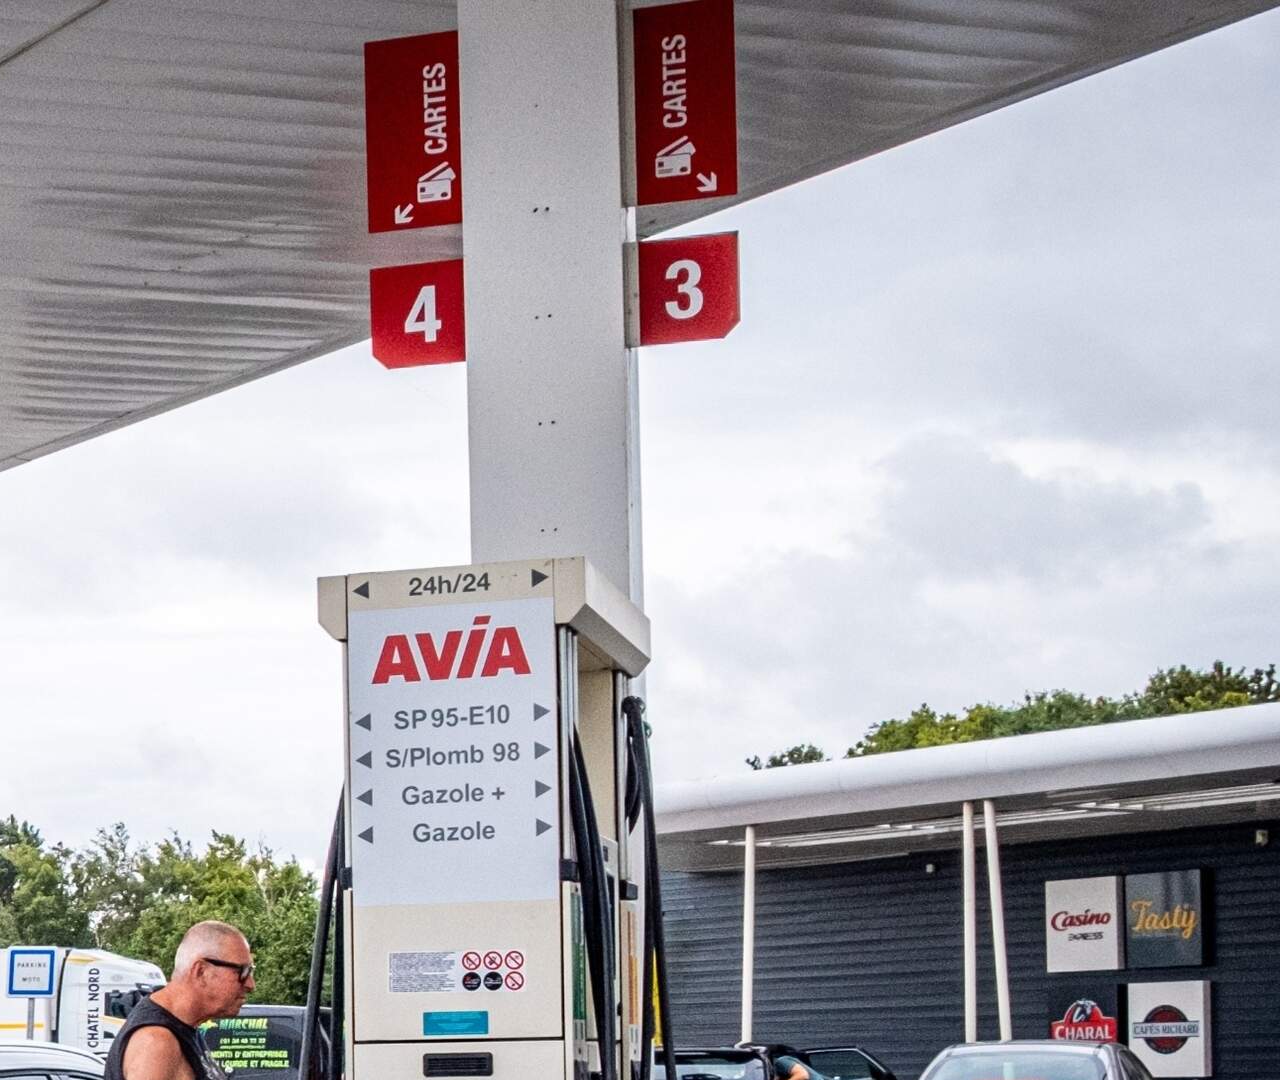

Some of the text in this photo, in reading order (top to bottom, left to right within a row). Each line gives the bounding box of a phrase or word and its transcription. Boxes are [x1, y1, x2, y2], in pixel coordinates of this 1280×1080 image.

[662, 34, 687, 129] CARTES
[422, 62, 447, 155] CARTES
[664, 259, 704, 320] 3
[404, 285, 442, 343] 4
[408, 572, 491, 597] 24h/24
[385, 741, 521, 769] S/Plomb 98
[401, 783, 485, 806] Gazole
[412, 820, 496, 843] Gazole
[1050, 908, 1112, 932] Casino
[1131, 901, 1197, 939] Tasty
[87, 967, 101, 1048] CHATEL NORD
[219, 1018, 269, 1030] MARCHAL
[1054, 1024, 1113, 1041] CHARAL
